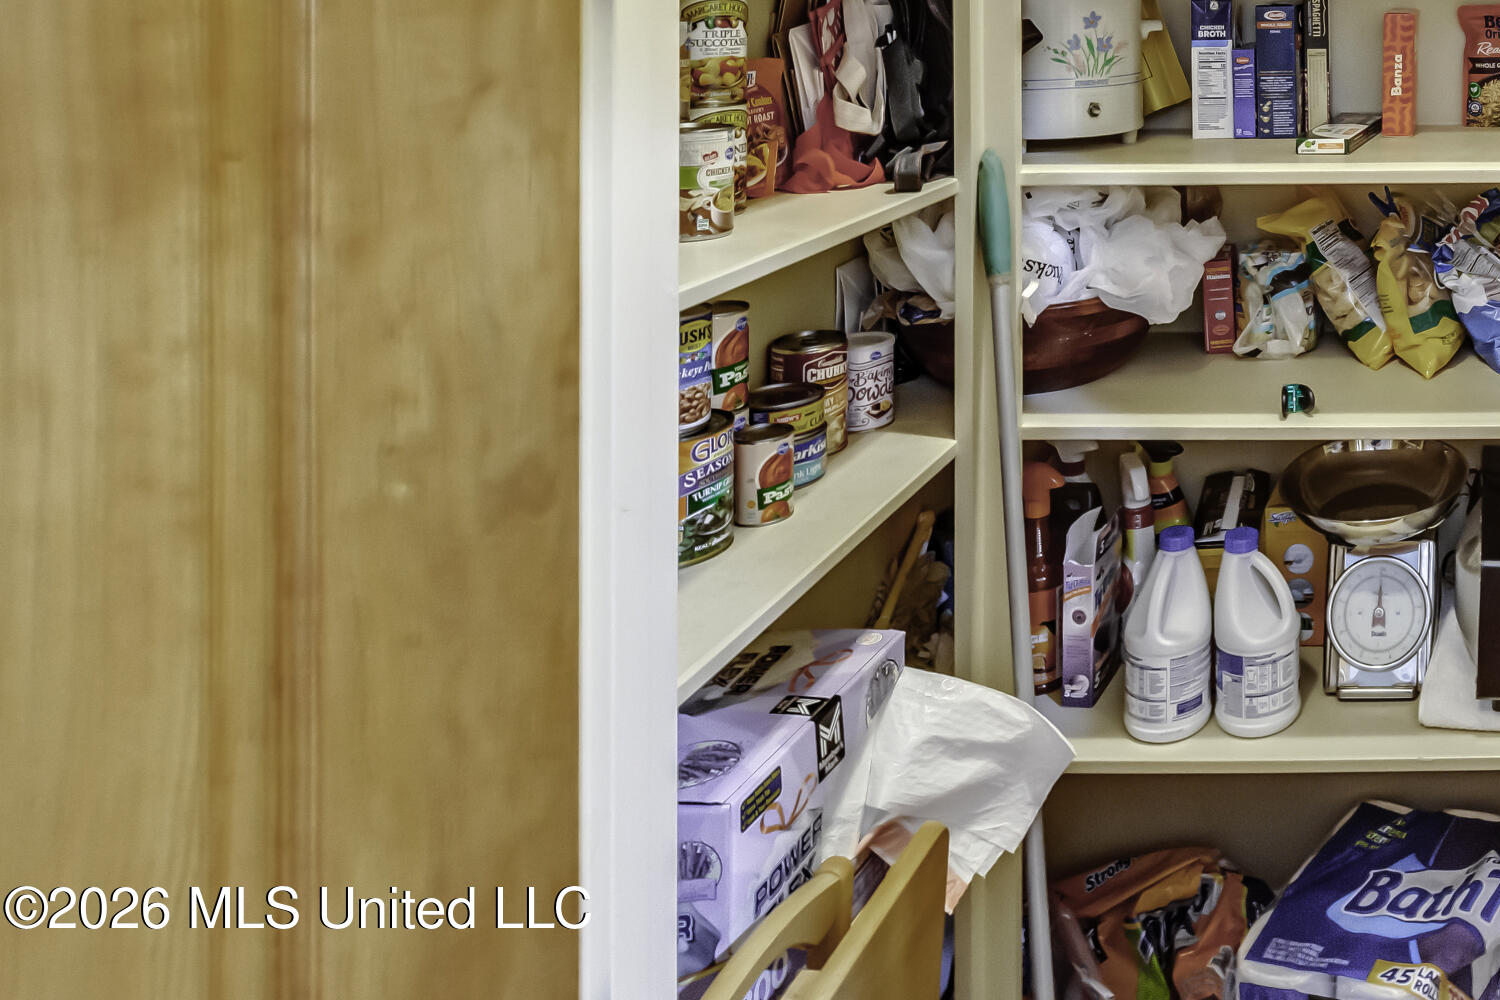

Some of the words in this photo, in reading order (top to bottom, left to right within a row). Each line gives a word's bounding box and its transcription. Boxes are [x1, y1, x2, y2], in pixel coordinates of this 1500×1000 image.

[703, 30, 741, 39] TRIPLE
[1198, 30, 1226, 38] BROTH
[1390, 54, 1403, 97] Banza
[755, 812, 823, 919] POWER
[1085, 856, 1131, 893] Strong
[1344, 869, 1484, 920] Bath
[1379, 967, 1416, 985] 45
